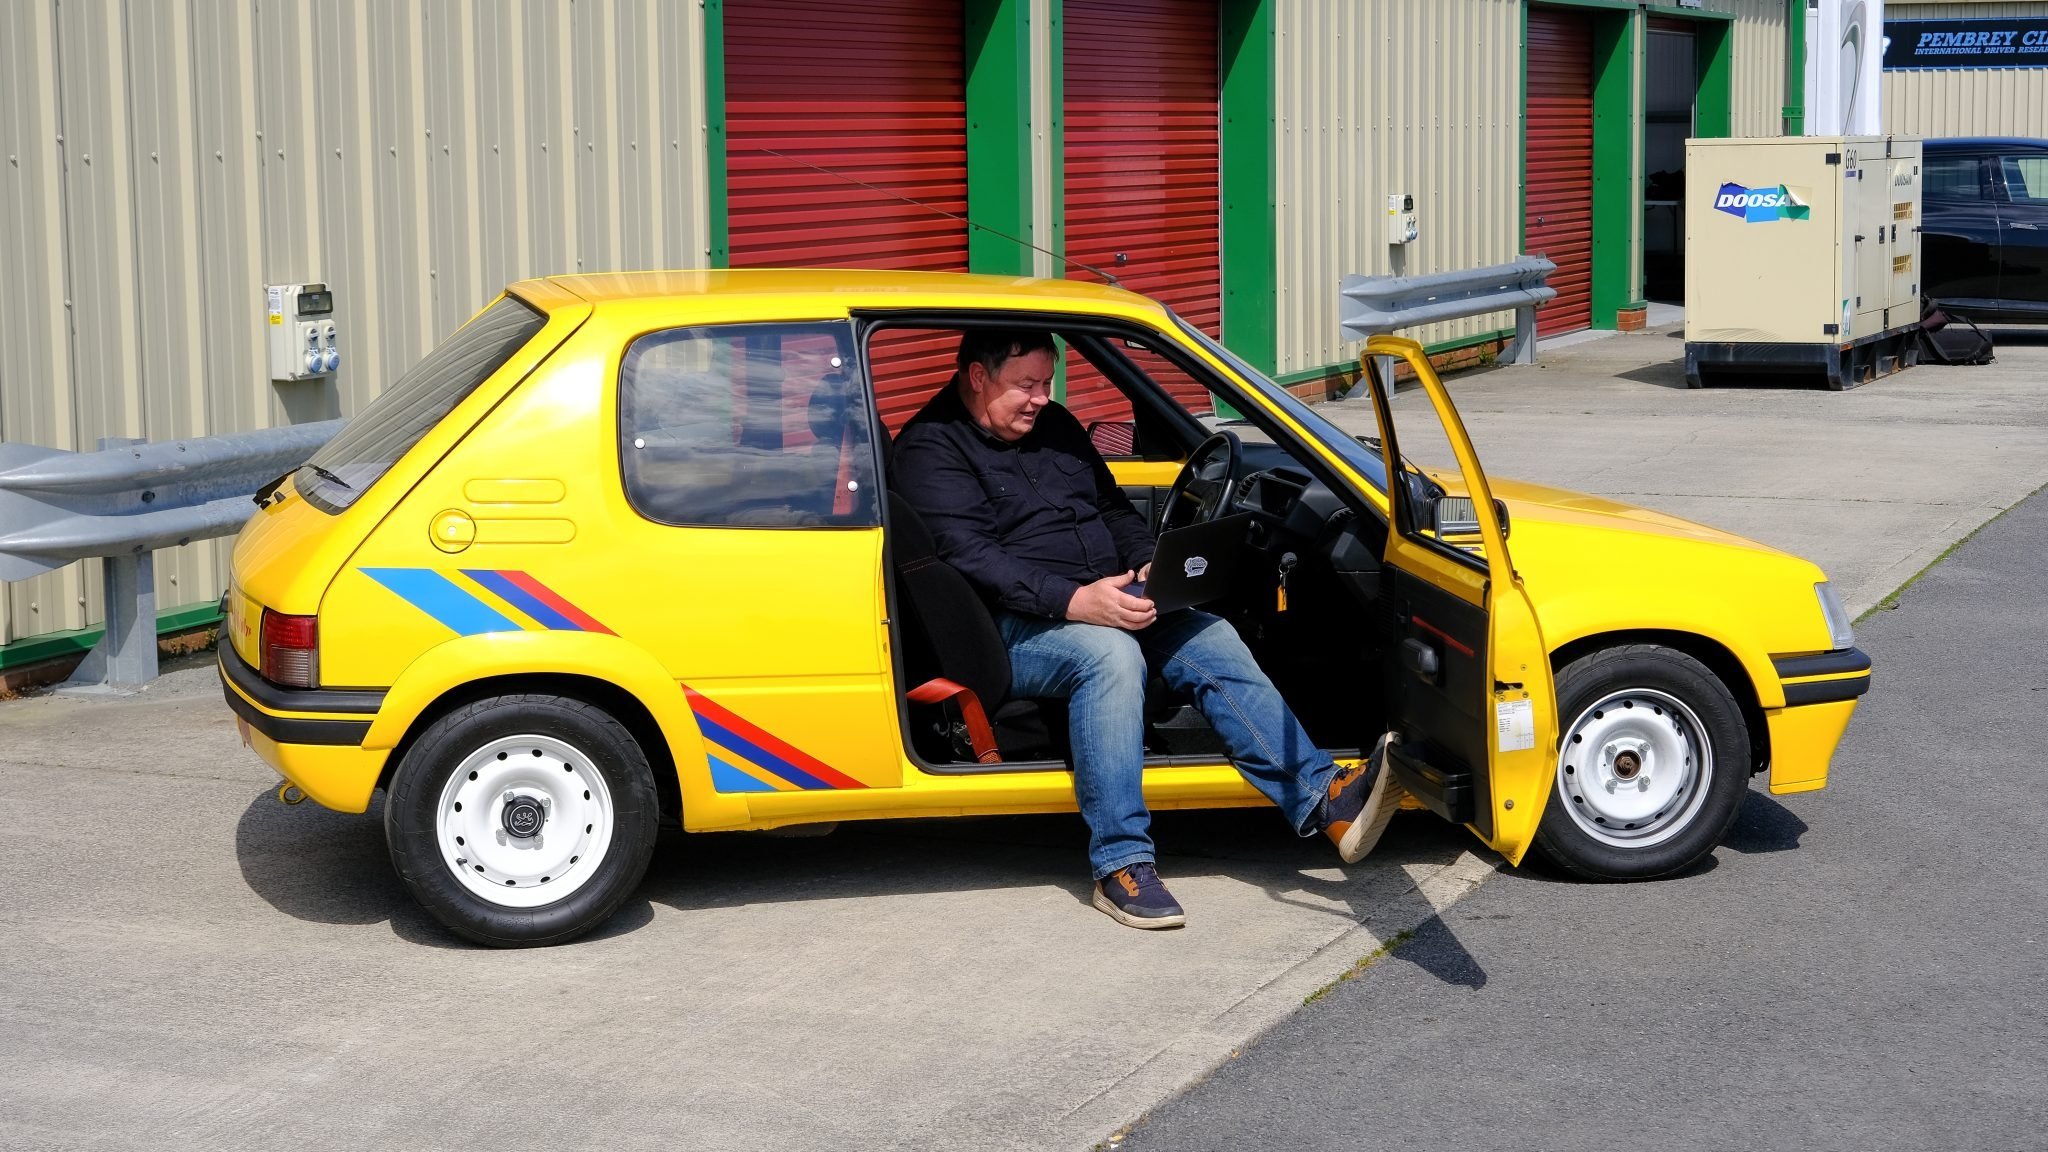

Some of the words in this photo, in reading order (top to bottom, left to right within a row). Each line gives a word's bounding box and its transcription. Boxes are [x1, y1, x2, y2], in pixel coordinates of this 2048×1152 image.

[1916, 31, 2018, 47] PEMBREY
[1914, 47, 1982, 55] INTERNATIONAL
[1846, 149, 1857, 170] G60
[1717, 193, 1797, 208] DOOSA
